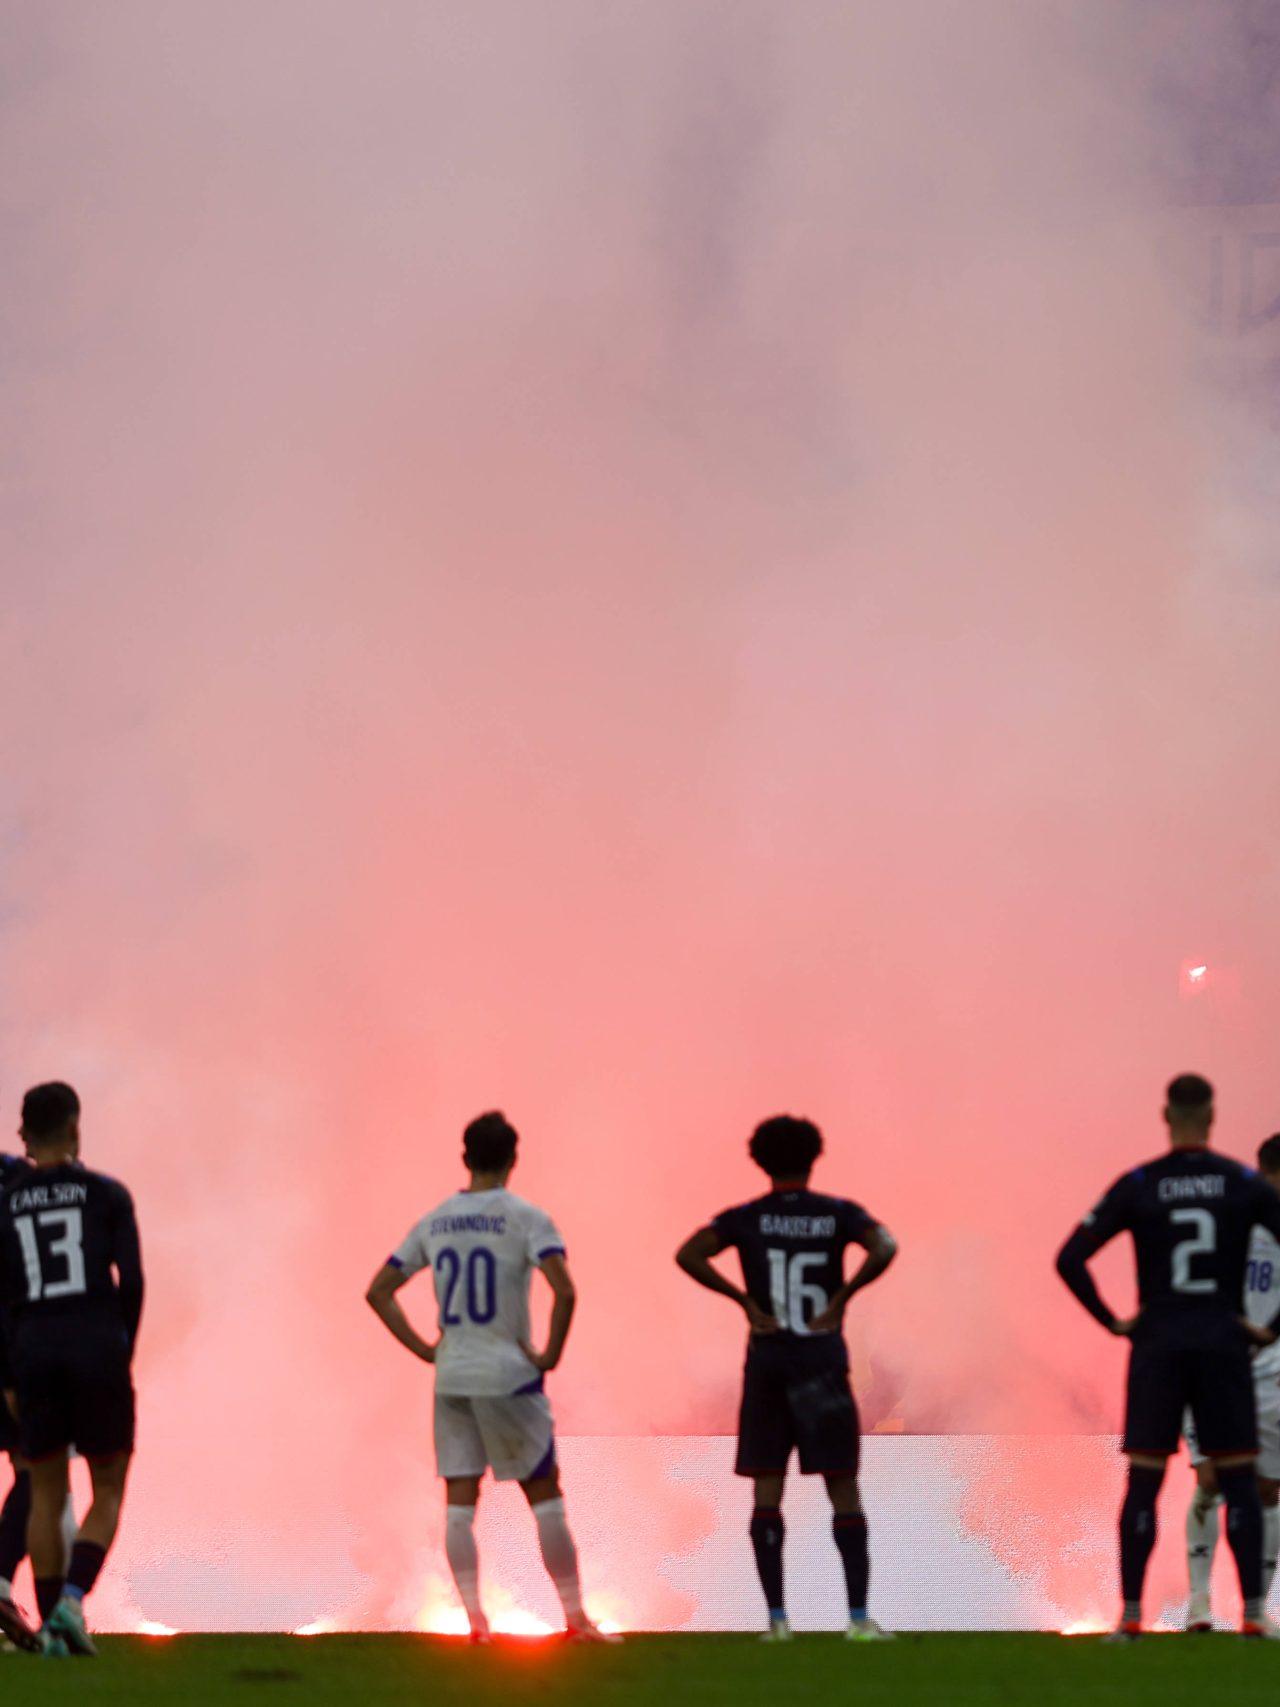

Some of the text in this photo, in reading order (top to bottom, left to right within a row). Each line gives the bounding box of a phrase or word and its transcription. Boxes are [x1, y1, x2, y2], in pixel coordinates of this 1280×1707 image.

[14, 1207, 86, 1301] 13
[436, 1246, 497, 1326] 20
[767, 1248, 830, 1336] 16
[1170, 1208, 1217, 1293] 2
[1248, 1260, 1273, 1292] 18
